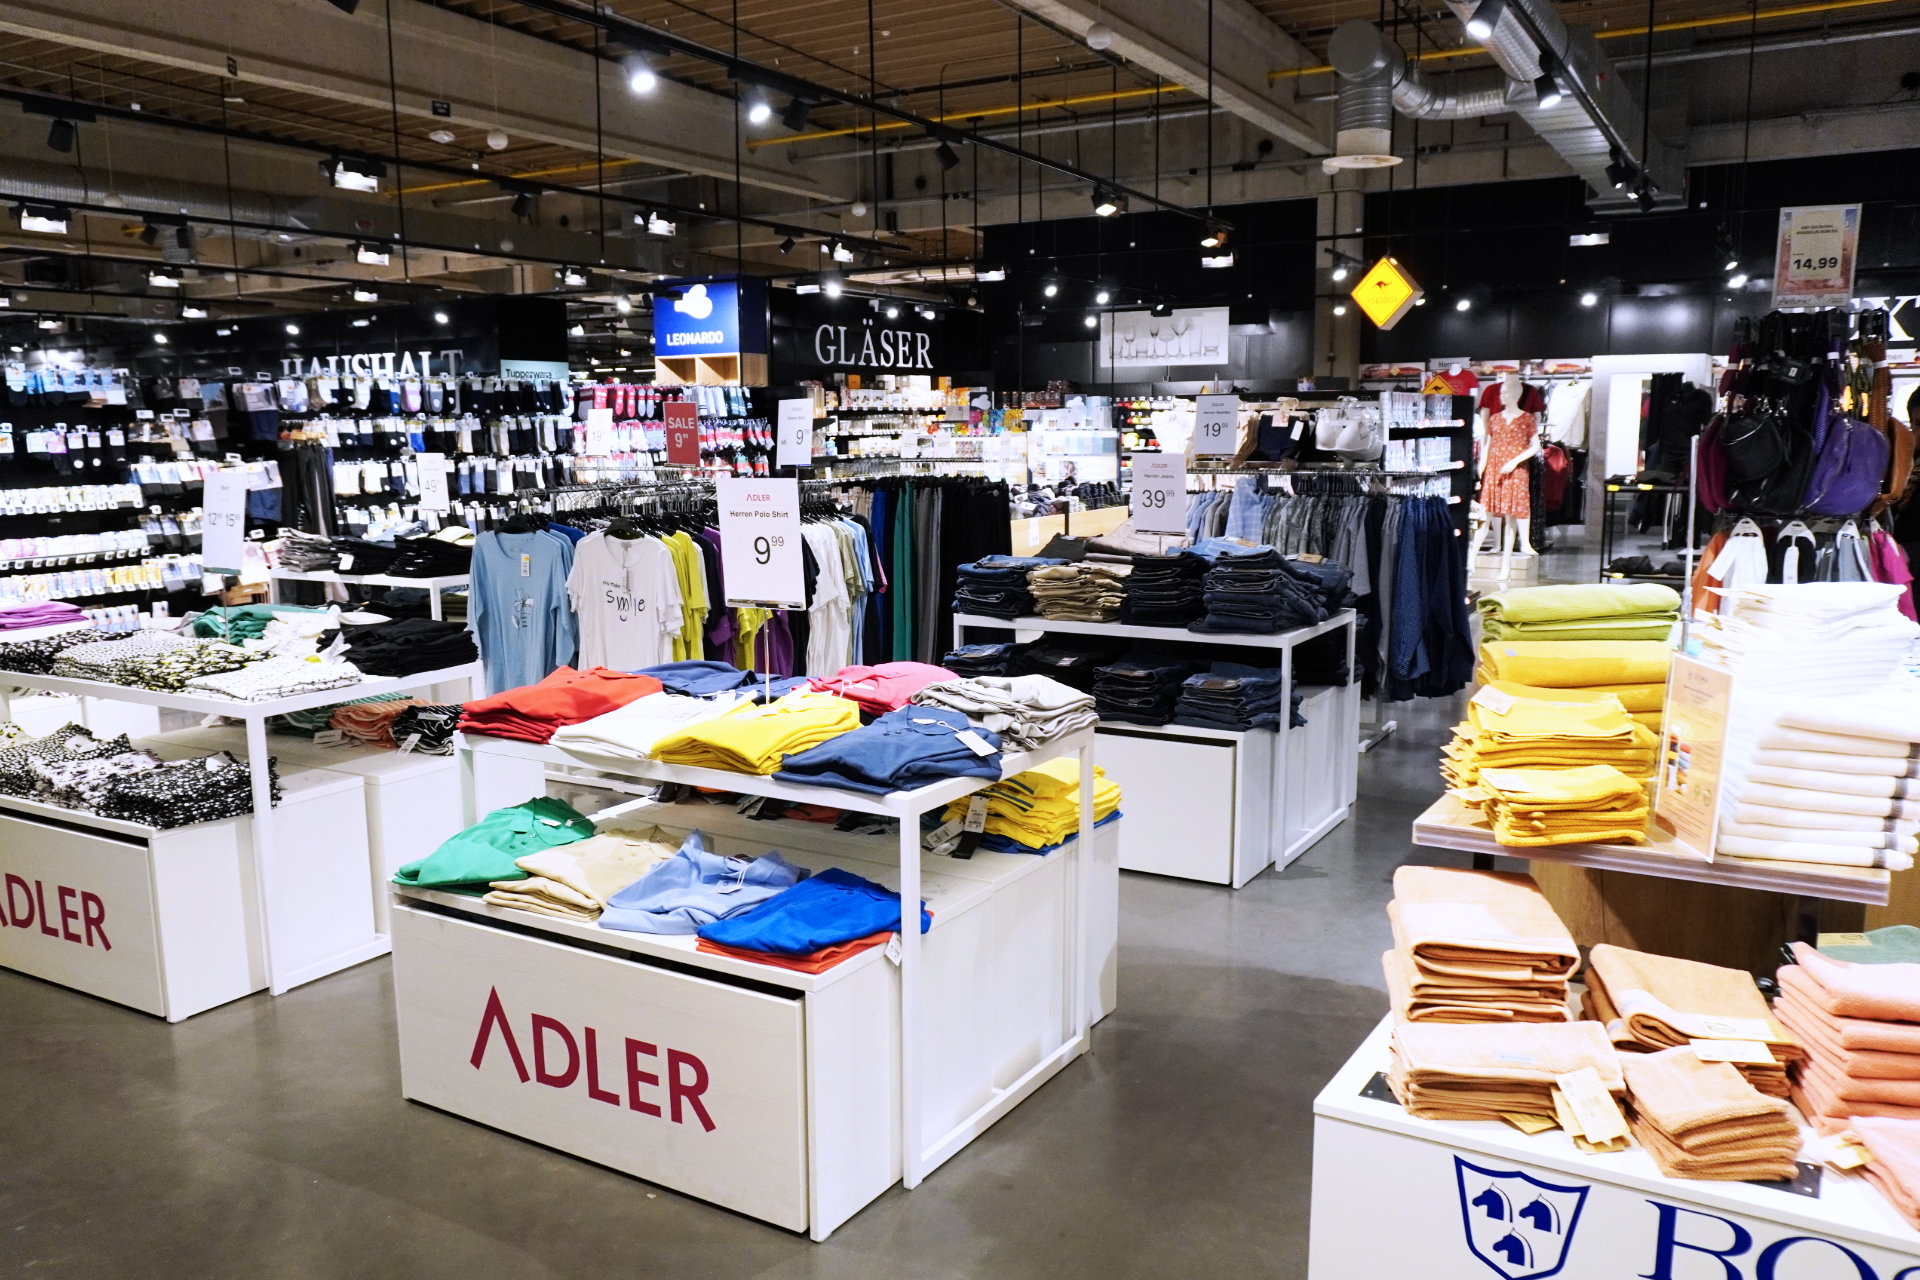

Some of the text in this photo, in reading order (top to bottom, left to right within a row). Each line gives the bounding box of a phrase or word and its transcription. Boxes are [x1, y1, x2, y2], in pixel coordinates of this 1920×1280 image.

[1793, 257, 1838, 271] 14,99
[667, 331, 723, 346] LEONARDO
[815, 318, 933, 369] GLÄSER
[668, 416, 695, 429] SALE
[1203, 422, 1221, 437] 19
[746, 493, 771, 502] ADLER
[1142, 489, 1166, 508] 39
[729, 510, 753, 518] Herren
[772, 511, 789, 519] Shirt
[754, 536, 771, 565] 9
[0, 872, 112, 952] DLER
[469, 984, 717, 1133] ADLER
